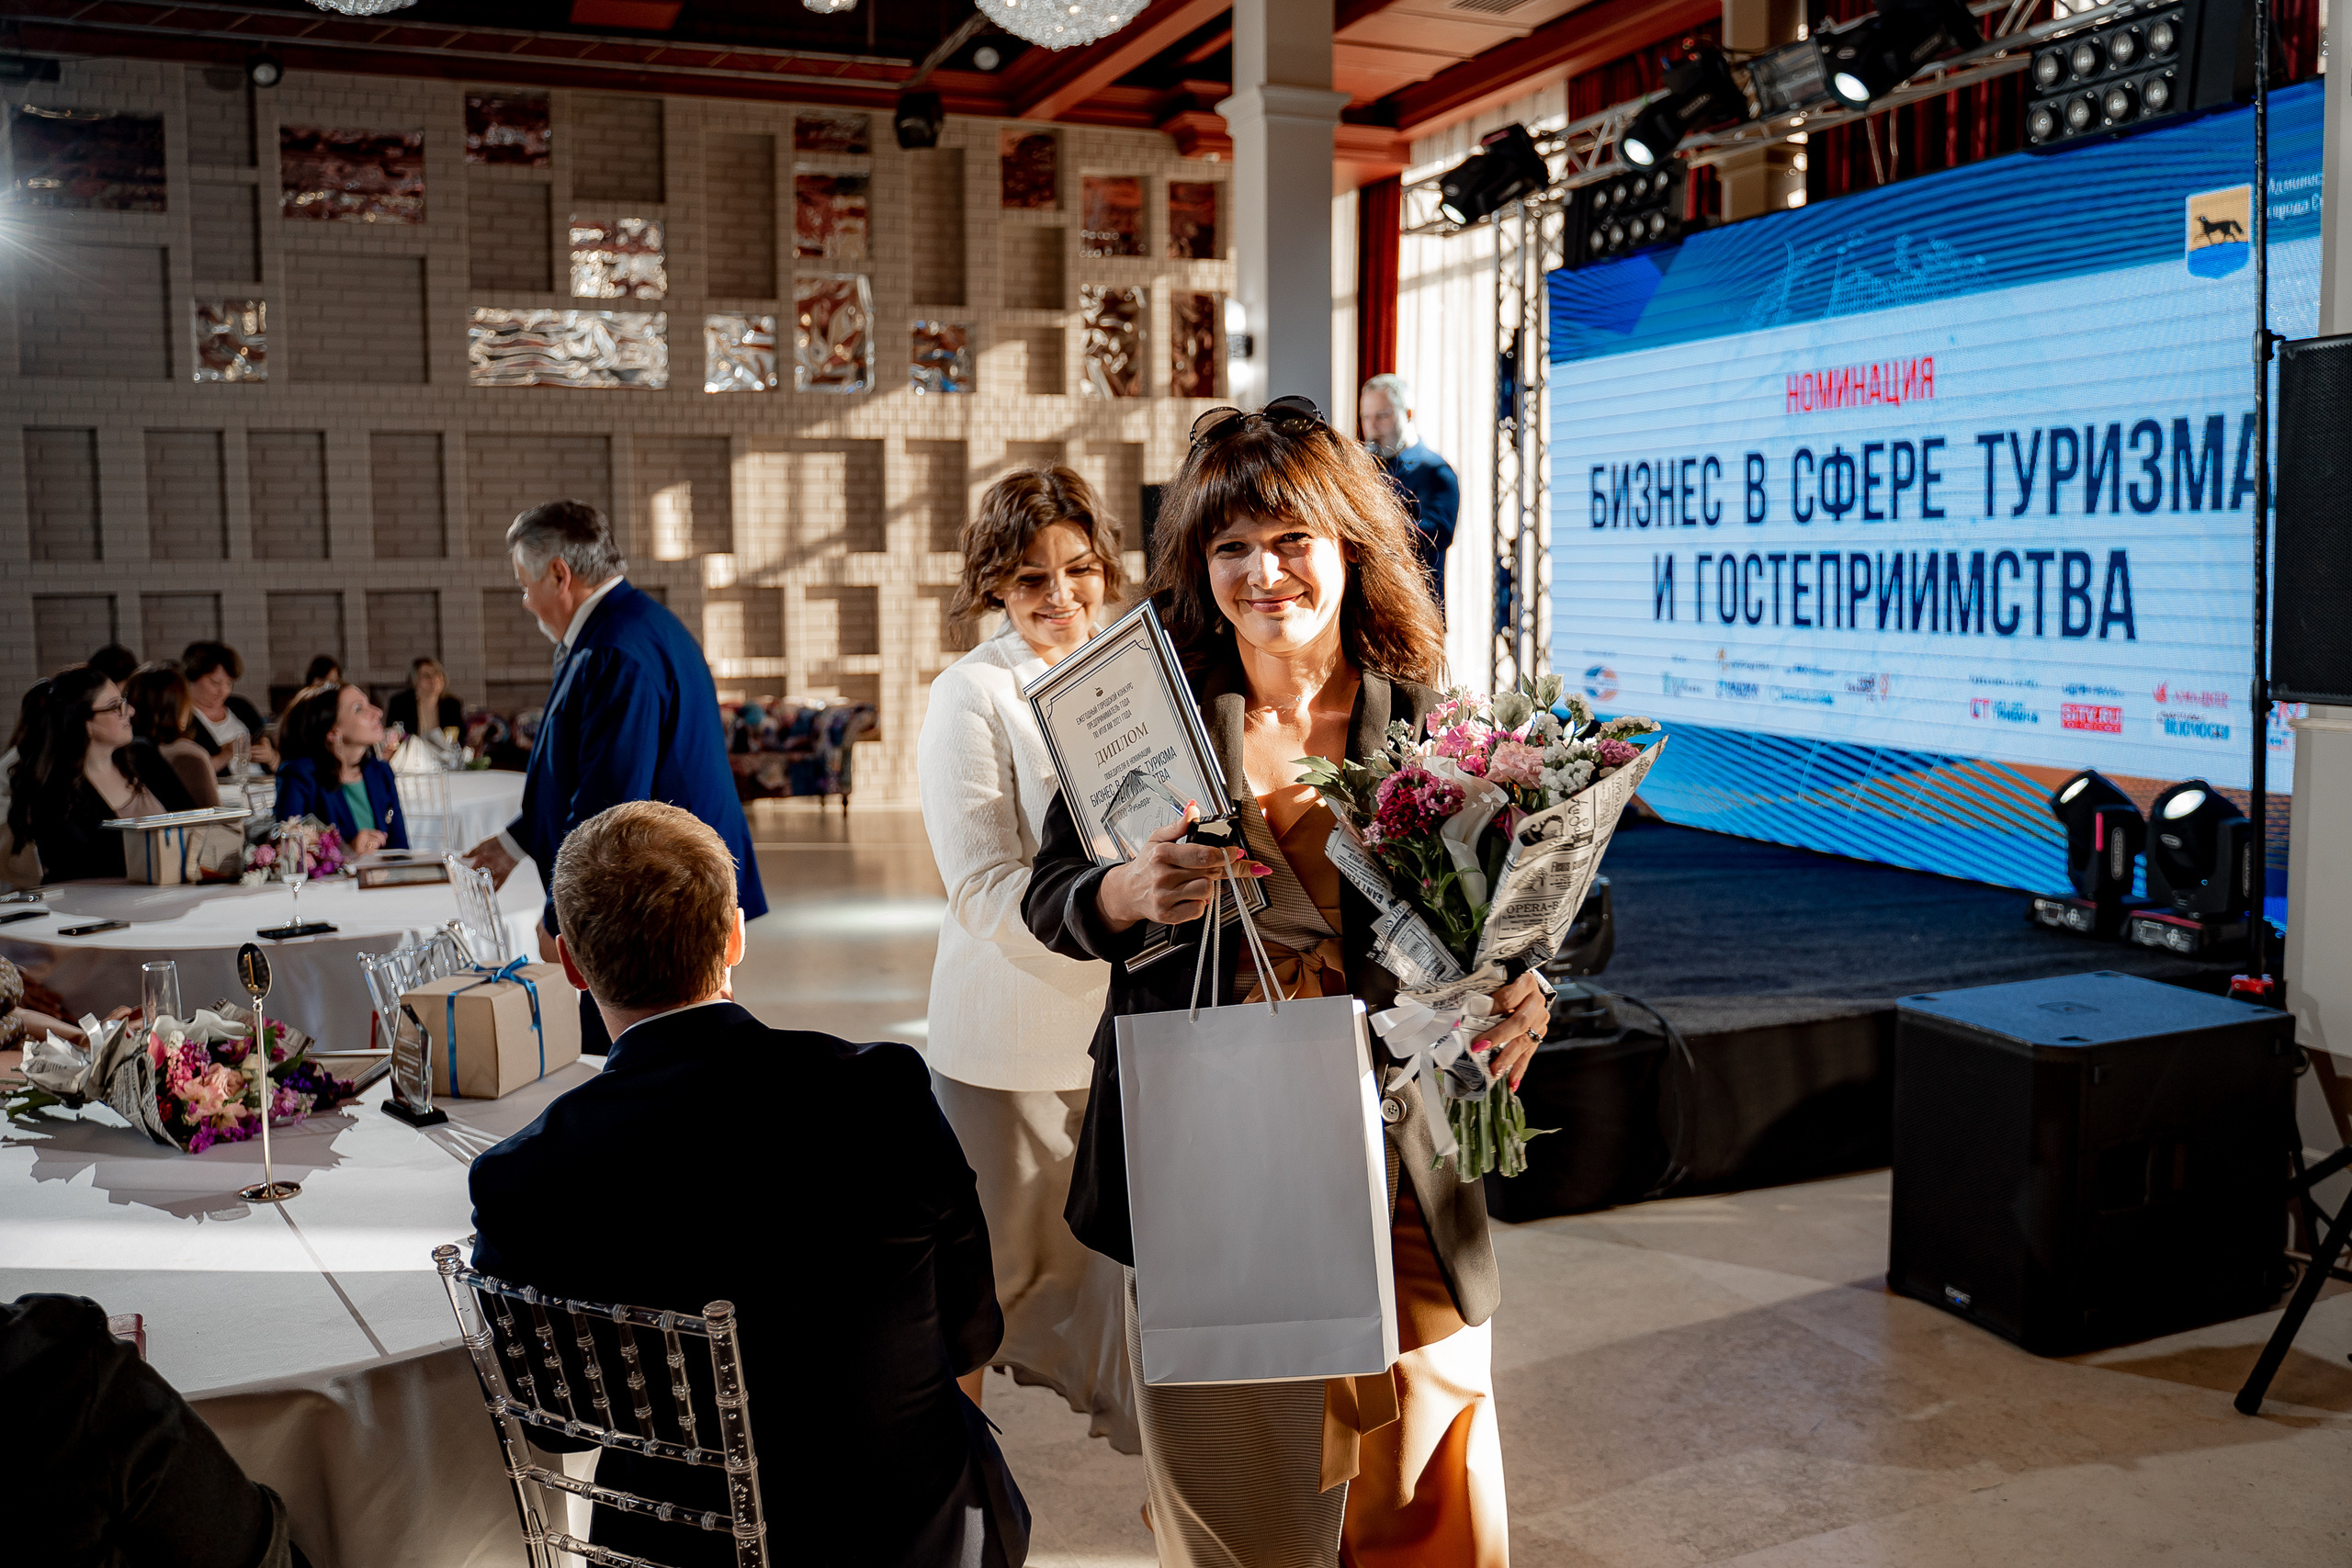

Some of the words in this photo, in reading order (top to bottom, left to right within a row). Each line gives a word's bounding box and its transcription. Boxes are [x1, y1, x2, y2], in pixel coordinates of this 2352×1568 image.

[1787, 355, 1934, 413] НОМИНАЦИЯ
[1590, 455, 1723, 529] БИЗНЕС
[1745, 452, 1768, 525] В
[1792, 437, 1946, 523] СФЕРЕ
[1654, 554, 1675, 622] И
[1697, 549, 2136, 641] ГОСТЕПРИИМСТВА
[1087, 704, 1120, 730] ПРЕДПРИНИМАТЕЛЬ
[1119, 697, 1130, 708] ГОДА
[1097, 692, 1117, 712] ГОРОДСКОЙ
[1116, 682, 1134, 699] КОНКУРС
[1113, 716, 1123, 728] 2021
[1121, 709, 1132, 721] ГОДА
[1094, 721, 1149, 767] ДИПЛОМ
[1090, 784, 1115, 807] БИЗНЕС
[1144, 746, 1177, 773] ТУРИЗМА
